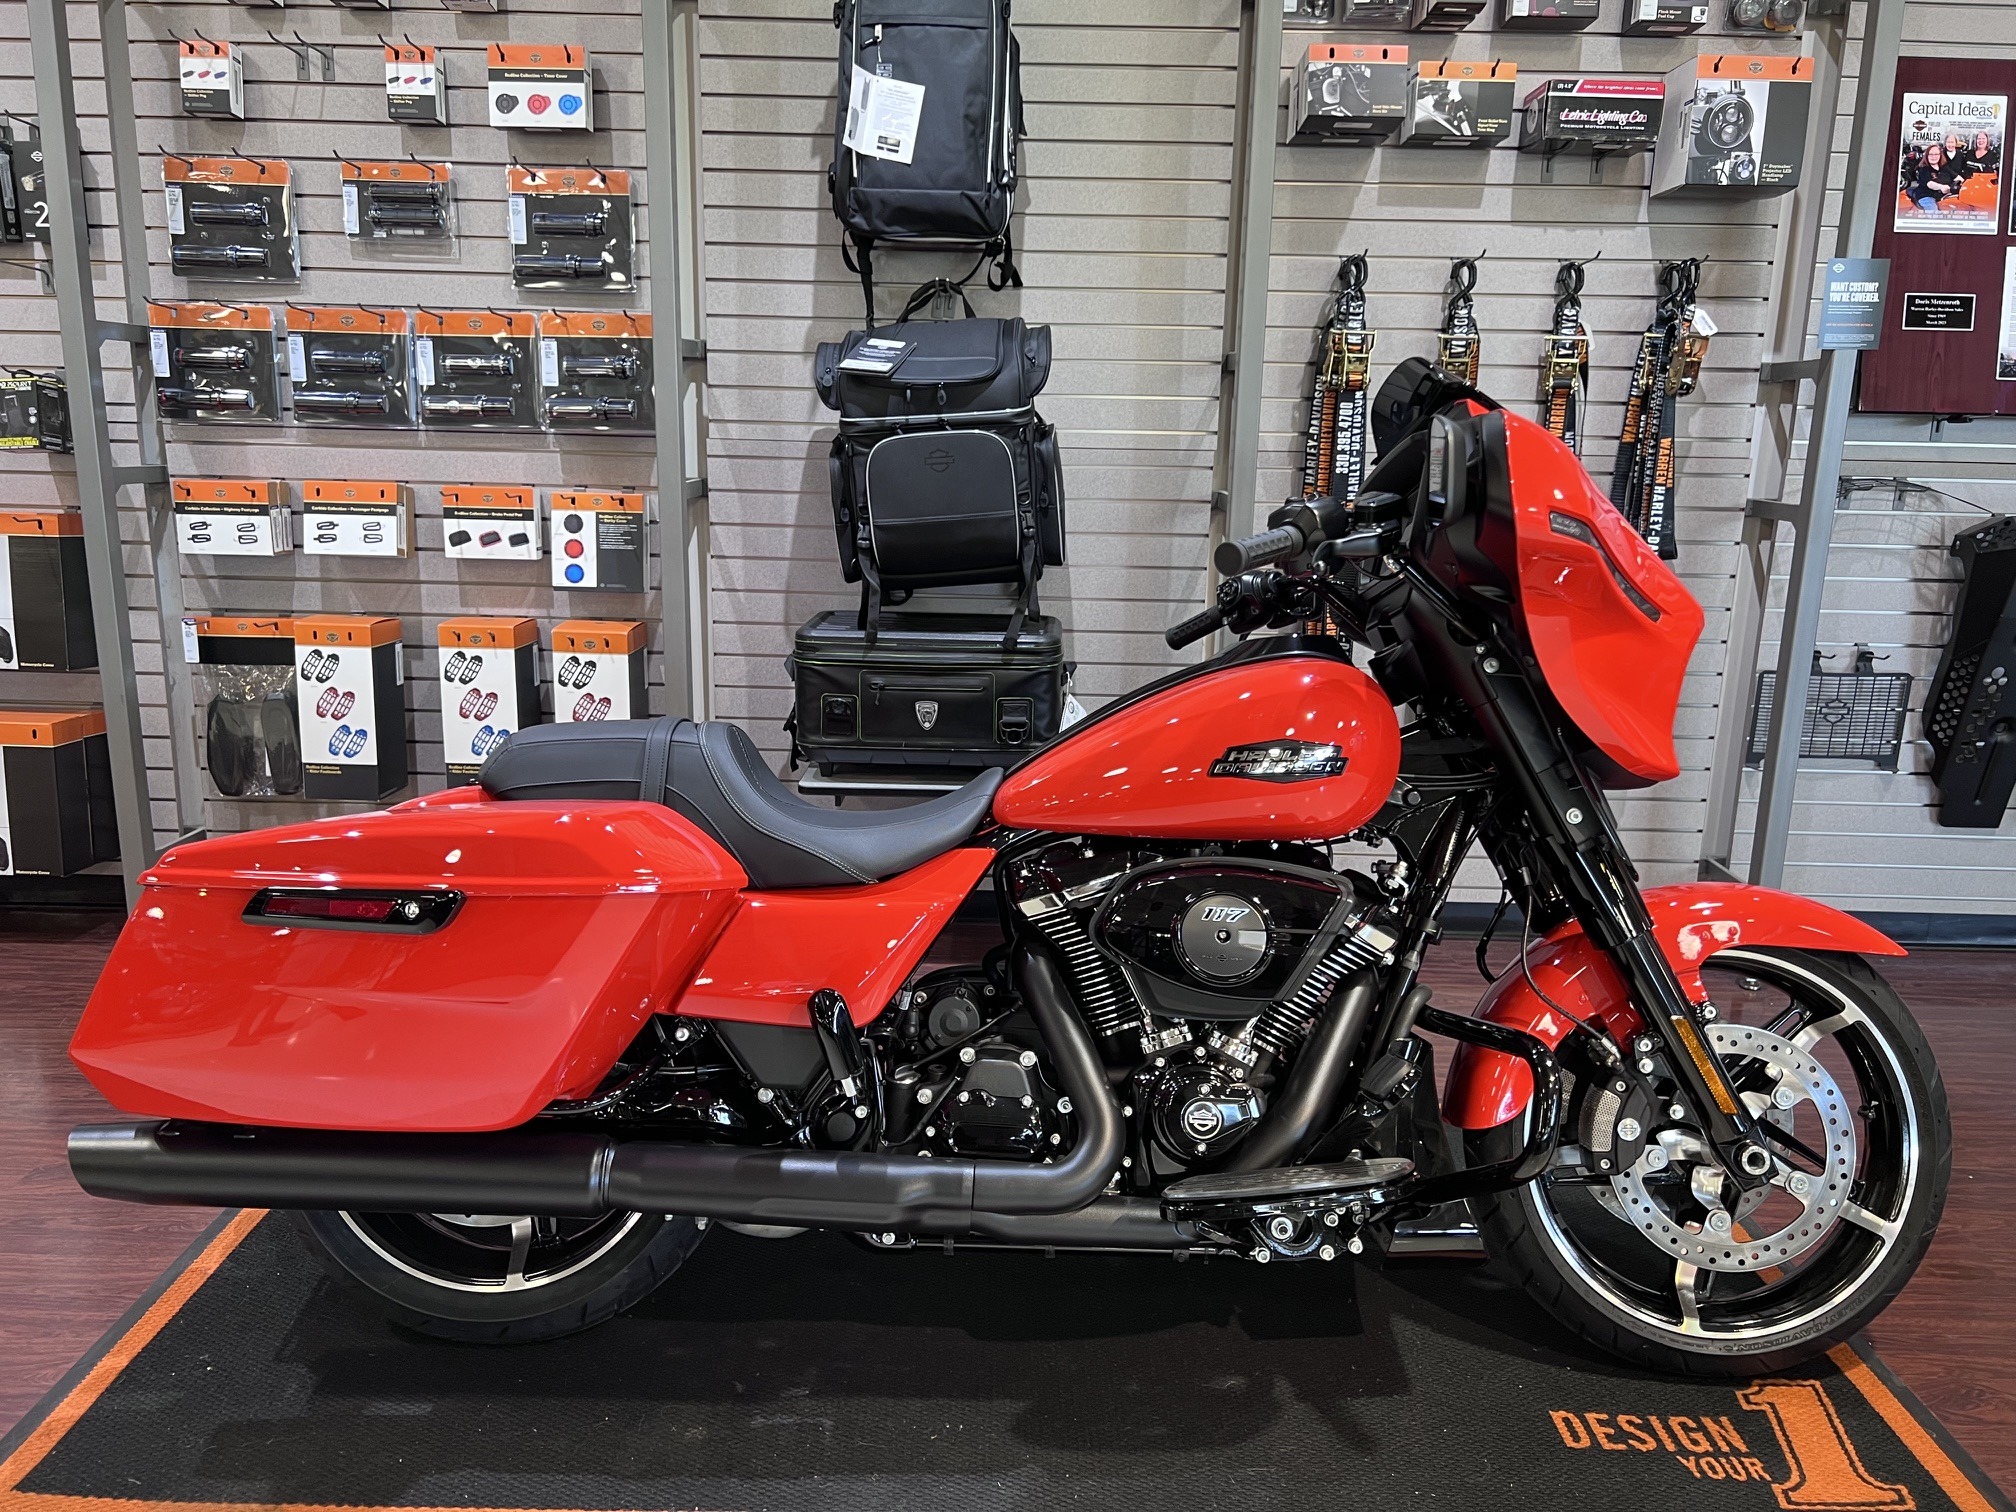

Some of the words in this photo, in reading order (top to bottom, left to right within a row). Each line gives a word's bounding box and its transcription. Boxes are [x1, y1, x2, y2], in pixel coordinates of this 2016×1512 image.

[1560, 108, 1590, 121] Letric
[1590, 108, 1629, 125] Lighting
[1909, 101, 1955, 118] Capital
[1912, 132, 1941, 142] FEMALES
[33, 201, 51, 228] 2
[1830, 282, 1850, 292] WANT
[1849, 282, 1879, 292] CUSTOM?
[1829, 292, 1850, 302] YOU'RE
[1850, 292, 1880, 303] COVERED.
[1335, 402, 1354, 474] 330.395.4700
[1655, 437, 1672, 484] WARREN
[1647, 485, 1666, 555] HARLEY-DA
[1214, 761, 1344, 775] DAVIDSON
[1201, 906, 1250, 923] 117
[1549, 1410, 1750, 1453] DESIGN
[1676, 1455, 1772, 1482] YOUR
